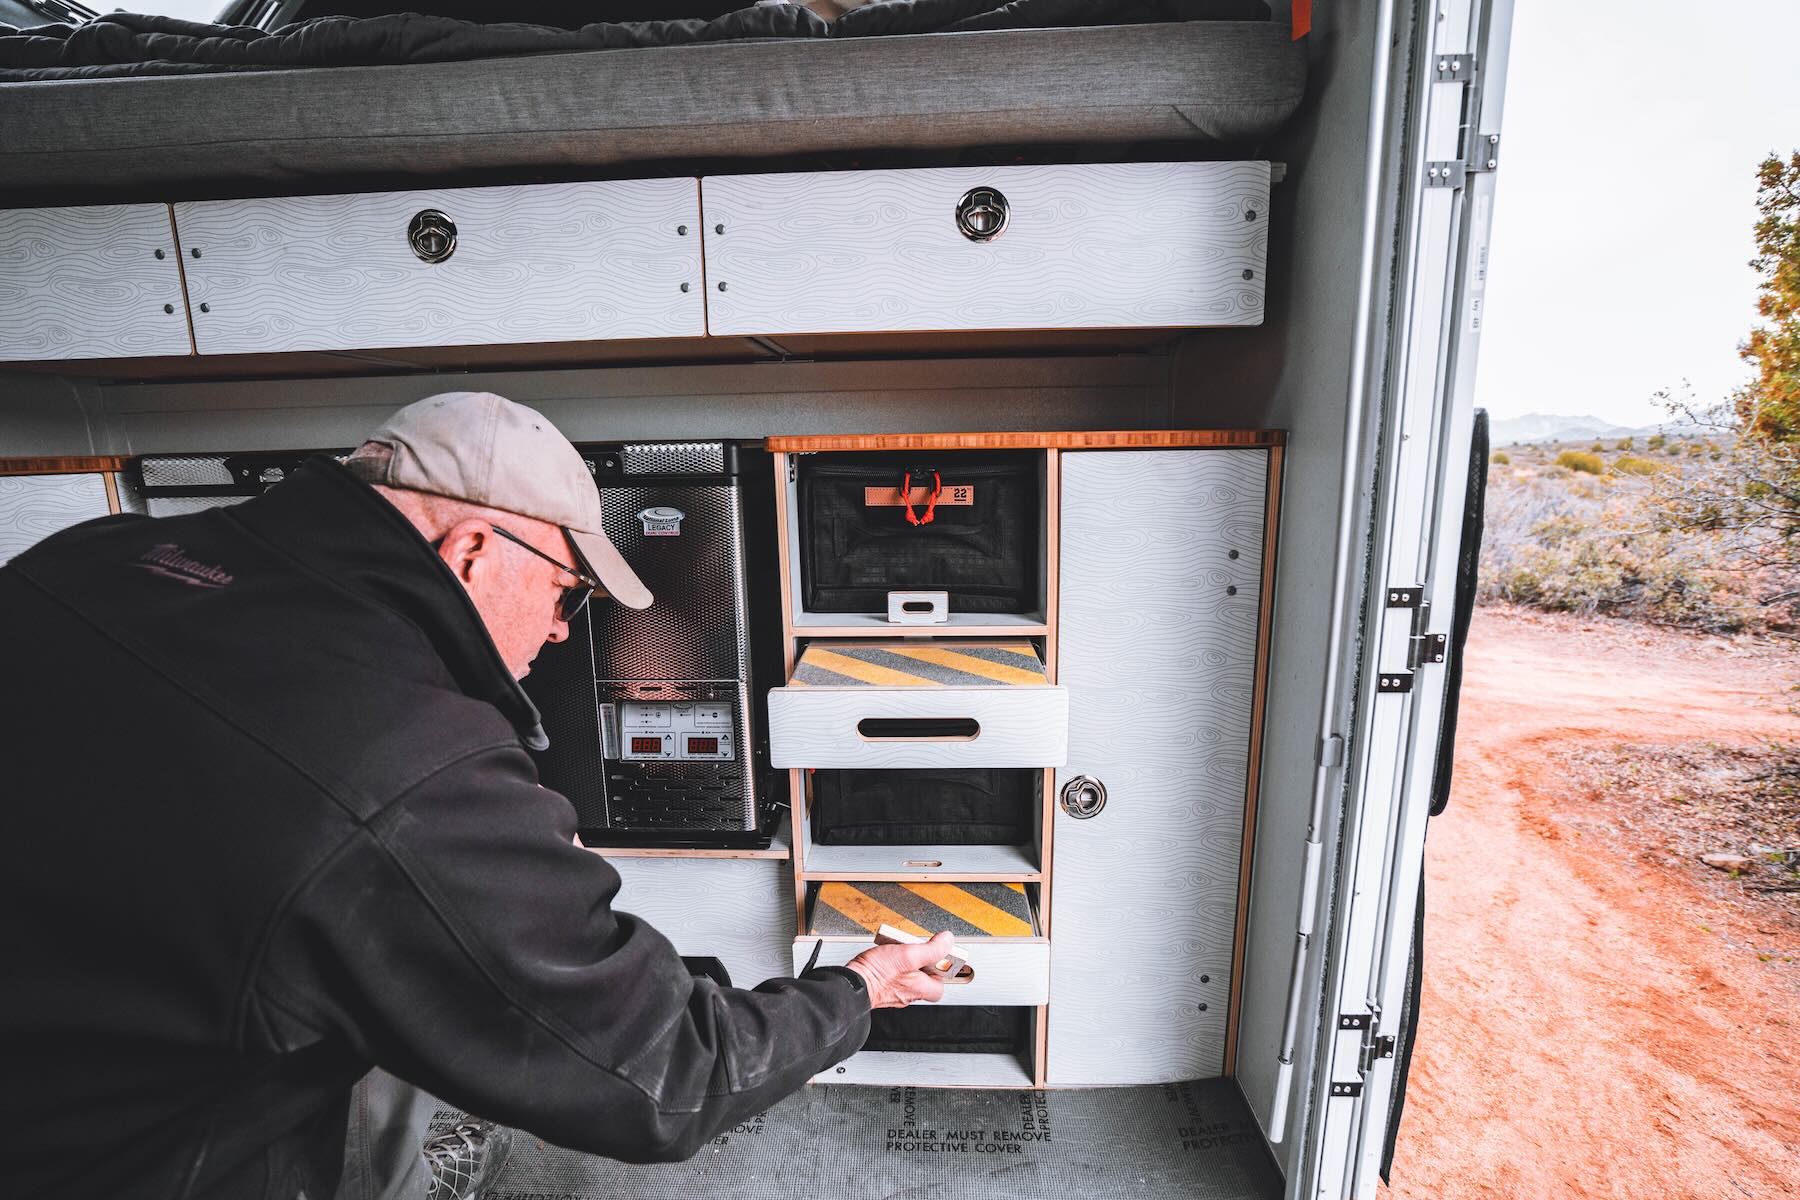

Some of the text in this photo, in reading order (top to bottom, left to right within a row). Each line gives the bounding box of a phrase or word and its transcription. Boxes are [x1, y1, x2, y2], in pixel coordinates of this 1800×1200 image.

[954, 487, 967, 498] 22
[647, 523, 676, 531] LEGACY
[888, 1129, 1052, 1142] DEALER MUST REMOVE
[886, 1141, 1023, 1154] PROTECTIVE COVER
